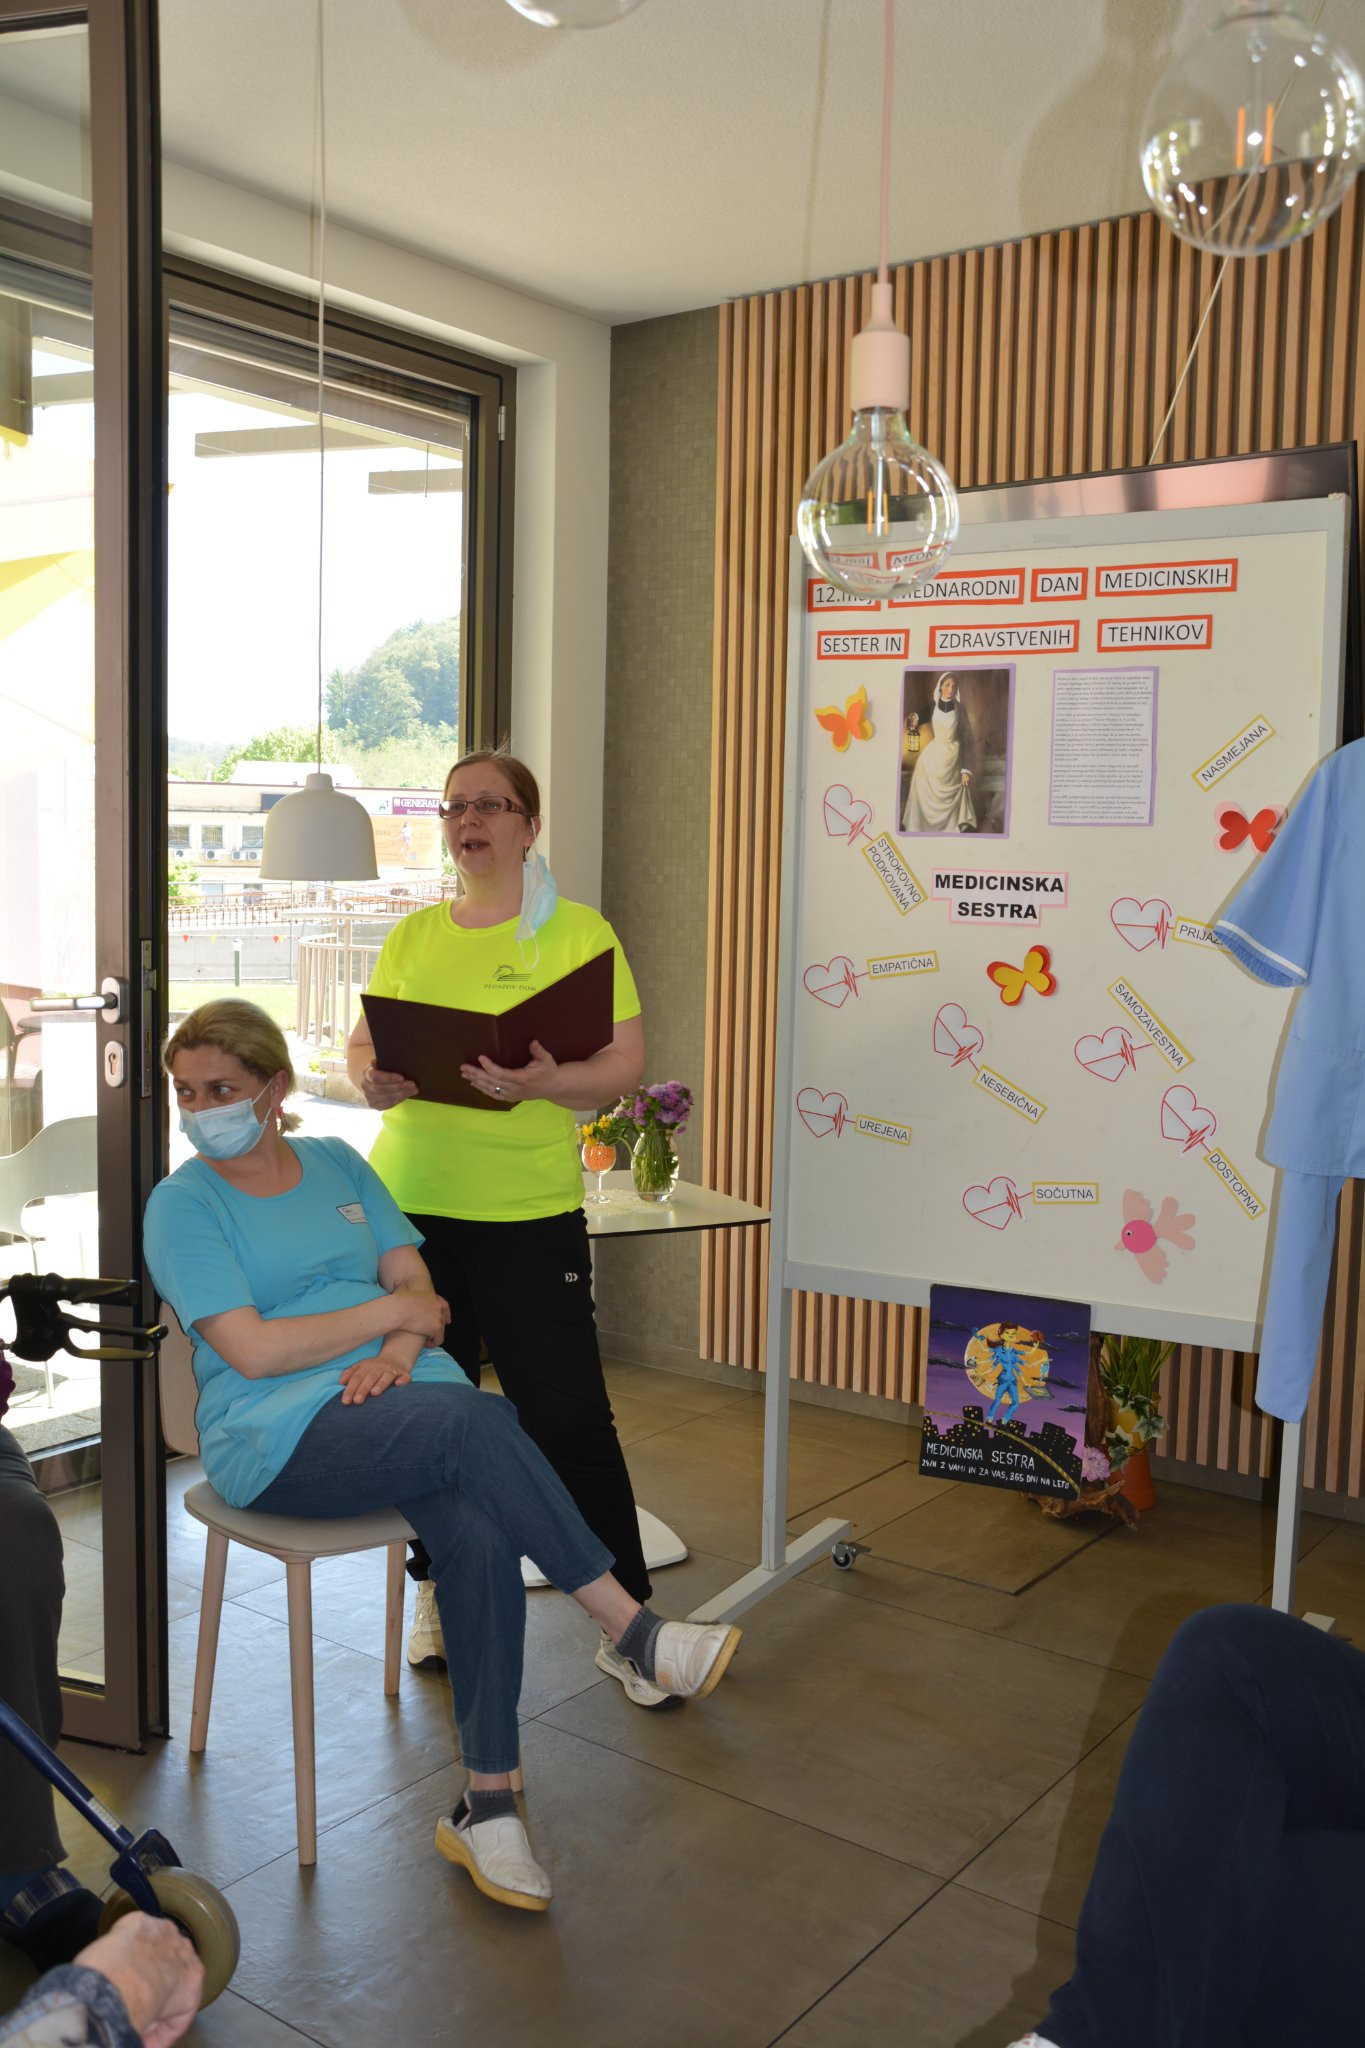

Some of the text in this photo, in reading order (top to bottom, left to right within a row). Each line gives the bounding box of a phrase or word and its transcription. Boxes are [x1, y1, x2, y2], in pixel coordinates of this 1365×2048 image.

[896, 578, 1017, 600] EDNARODNI
[1040, 576, 1079, 593] DAN
[1104, 568, 1229, 589] MEDICINSKIH
[823, 624, 1204, 653] SESTER IN ZDRAVSTVENIH TEHNIKOV
[1201, 725, 1268, 782] NASMEJANA
[867, 846, 910, 911] PODKOVANA
[877, 838, 922, 903] STROKOVNO
[935, 874, 1065, 893] MEDICINSKA
[957, 902, 1038, 919] SESTRA
[872, 957, 934, 974] EMPATIČNA
[1115, 983, 1184, 1066] SAMOZAVESTNA
[980, 1073, 1039, 1118] NESEBIČNA
[859, 1120, 908, 1142] UREJENA
[1036, 1187, 1094, 1199] SOČUTNA
[1209, 1153, 1259, 1215] DOSTOPNA
[926, 1442, 1035, 1471] MEDICINSKA SESTRA
[979, 1467, 989, 1476] ZA
[1009, 1472, 1024, 1482] 365
[1040, 1477, 1050, 1485] NA
